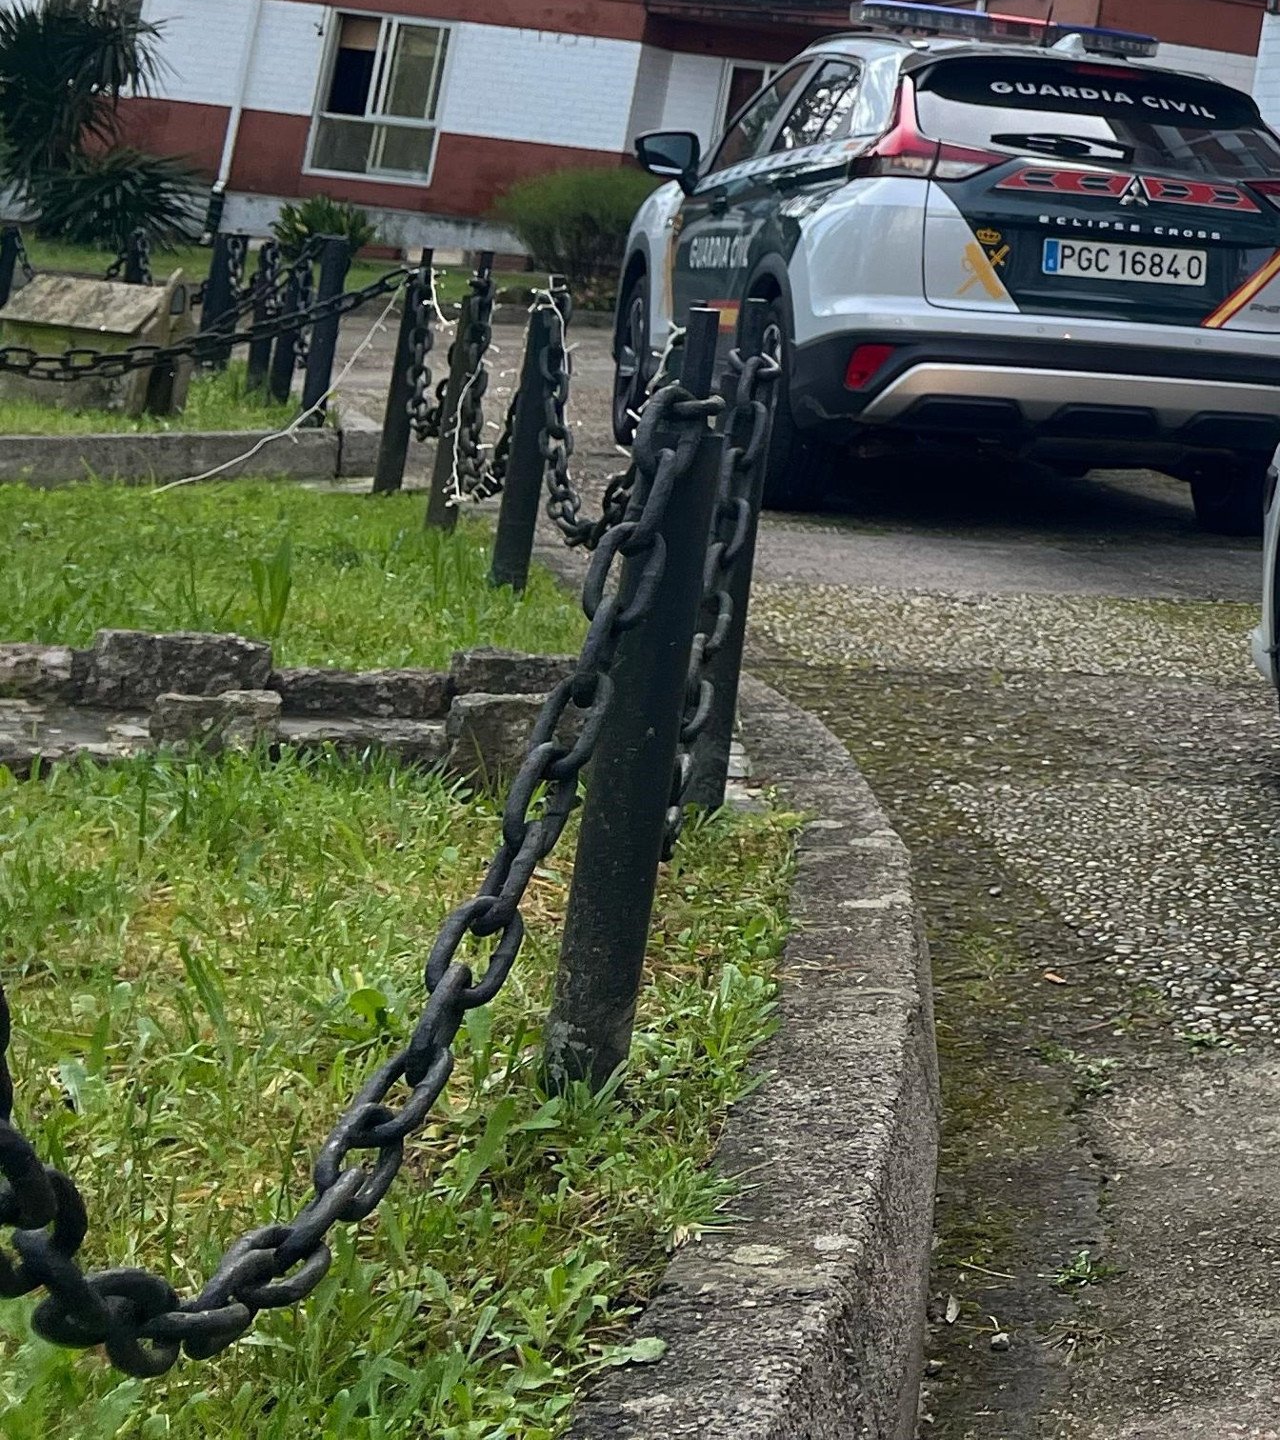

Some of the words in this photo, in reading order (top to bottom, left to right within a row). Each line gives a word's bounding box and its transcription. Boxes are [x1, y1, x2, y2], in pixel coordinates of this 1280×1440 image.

[990, 81, 1134, 105] GUARDIA
[1142, 95, 1216, 120] CIVIL
[1038, 215, 1141, 233] ECLIPSE
[1154, 225, 1221, 240] CROSS
